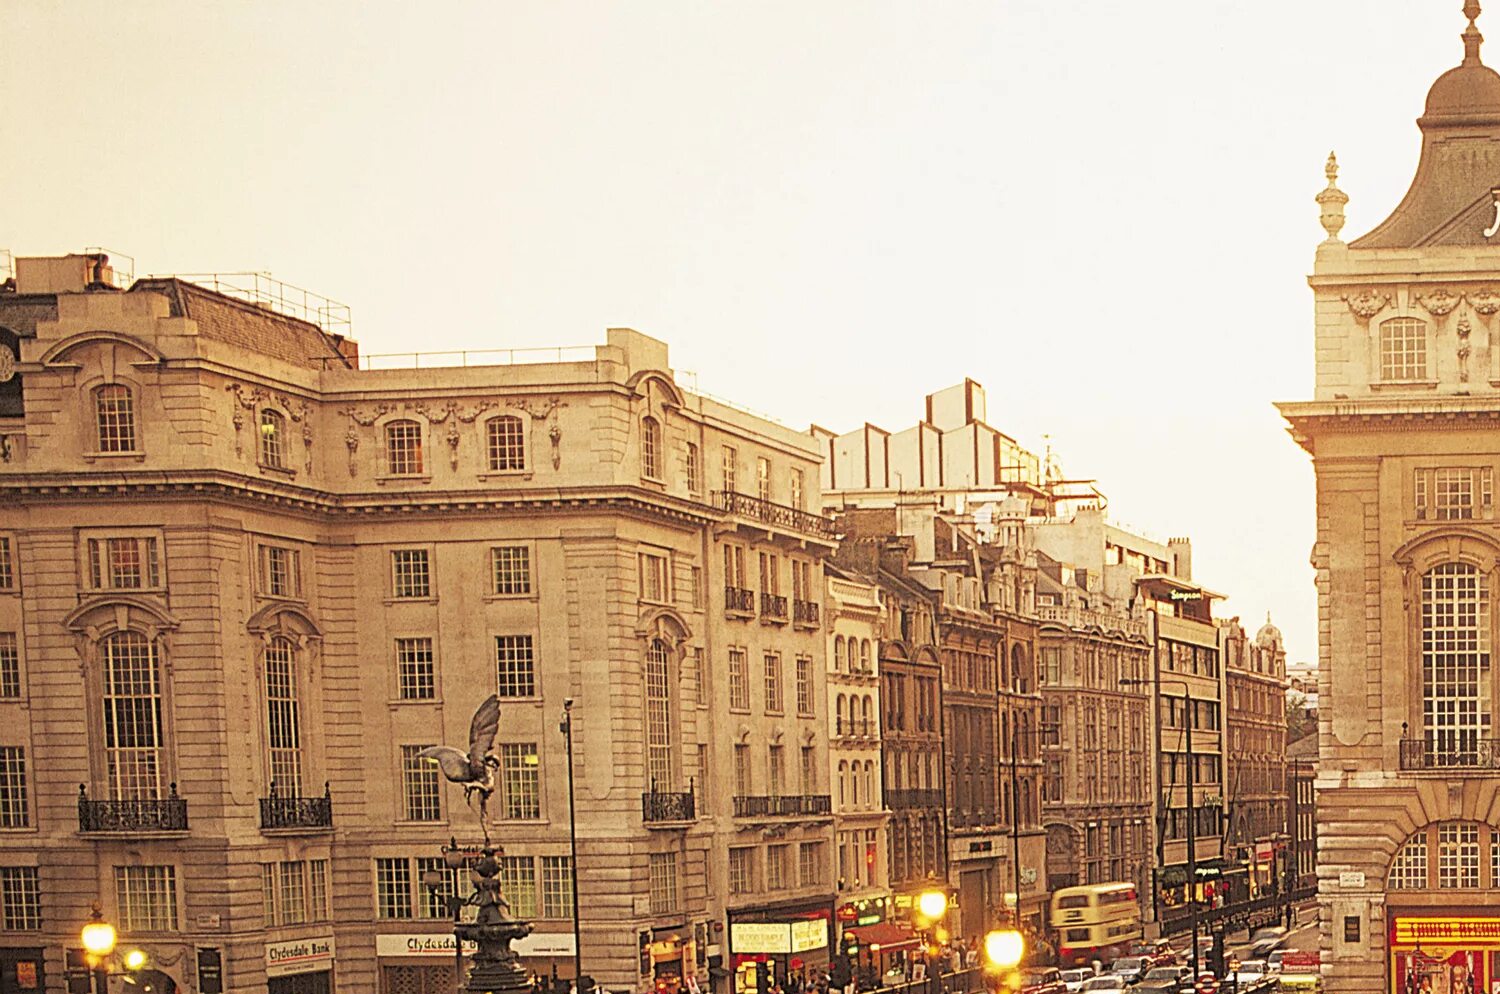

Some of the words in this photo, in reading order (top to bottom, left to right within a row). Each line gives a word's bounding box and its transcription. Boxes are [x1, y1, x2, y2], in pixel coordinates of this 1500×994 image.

[1170, 589, 1201, 602] Simpson
[270, 944, 308, 961] Clydesdale
[312, 941, 330, 954] Bank
[407, 937, 467, 953] Clydesdae
